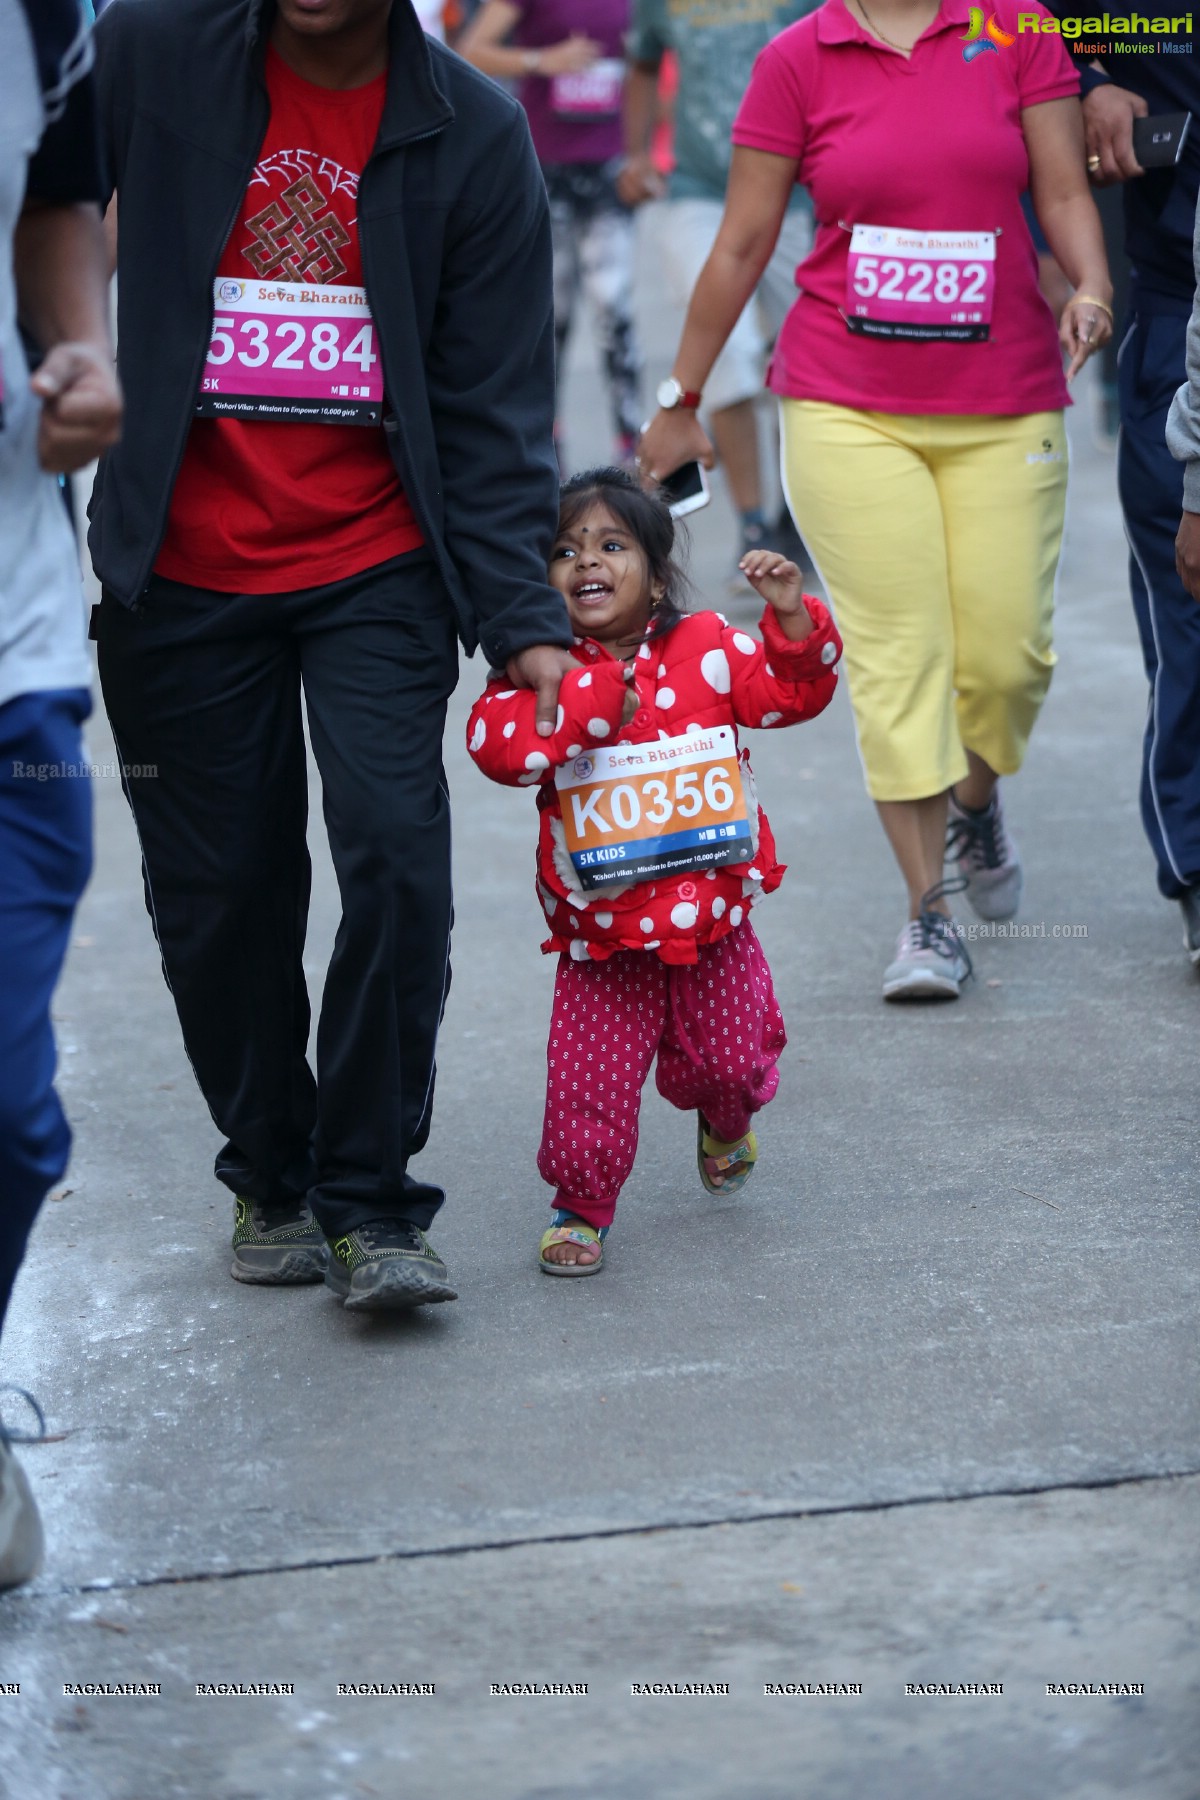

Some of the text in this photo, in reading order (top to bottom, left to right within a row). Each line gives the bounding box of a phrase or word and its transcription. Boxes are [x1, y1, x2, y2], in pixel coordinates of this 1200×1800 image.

[853, 256, 987, 304] 52282
[258, 287, 295, 303] Seva
[206, 316, 377, 373] 53284
[203, 378, 219, 390] 5K
[291, 406, 319, 415] Empower
[609, 737, 715, 768] Seva Bharathi
[571, 766, 734, 839] K0356
[580, 845, 626, 866] 5K KIDS
[637, 863, 660, 874] Mission
[667, 857, 693, 868] Empower
